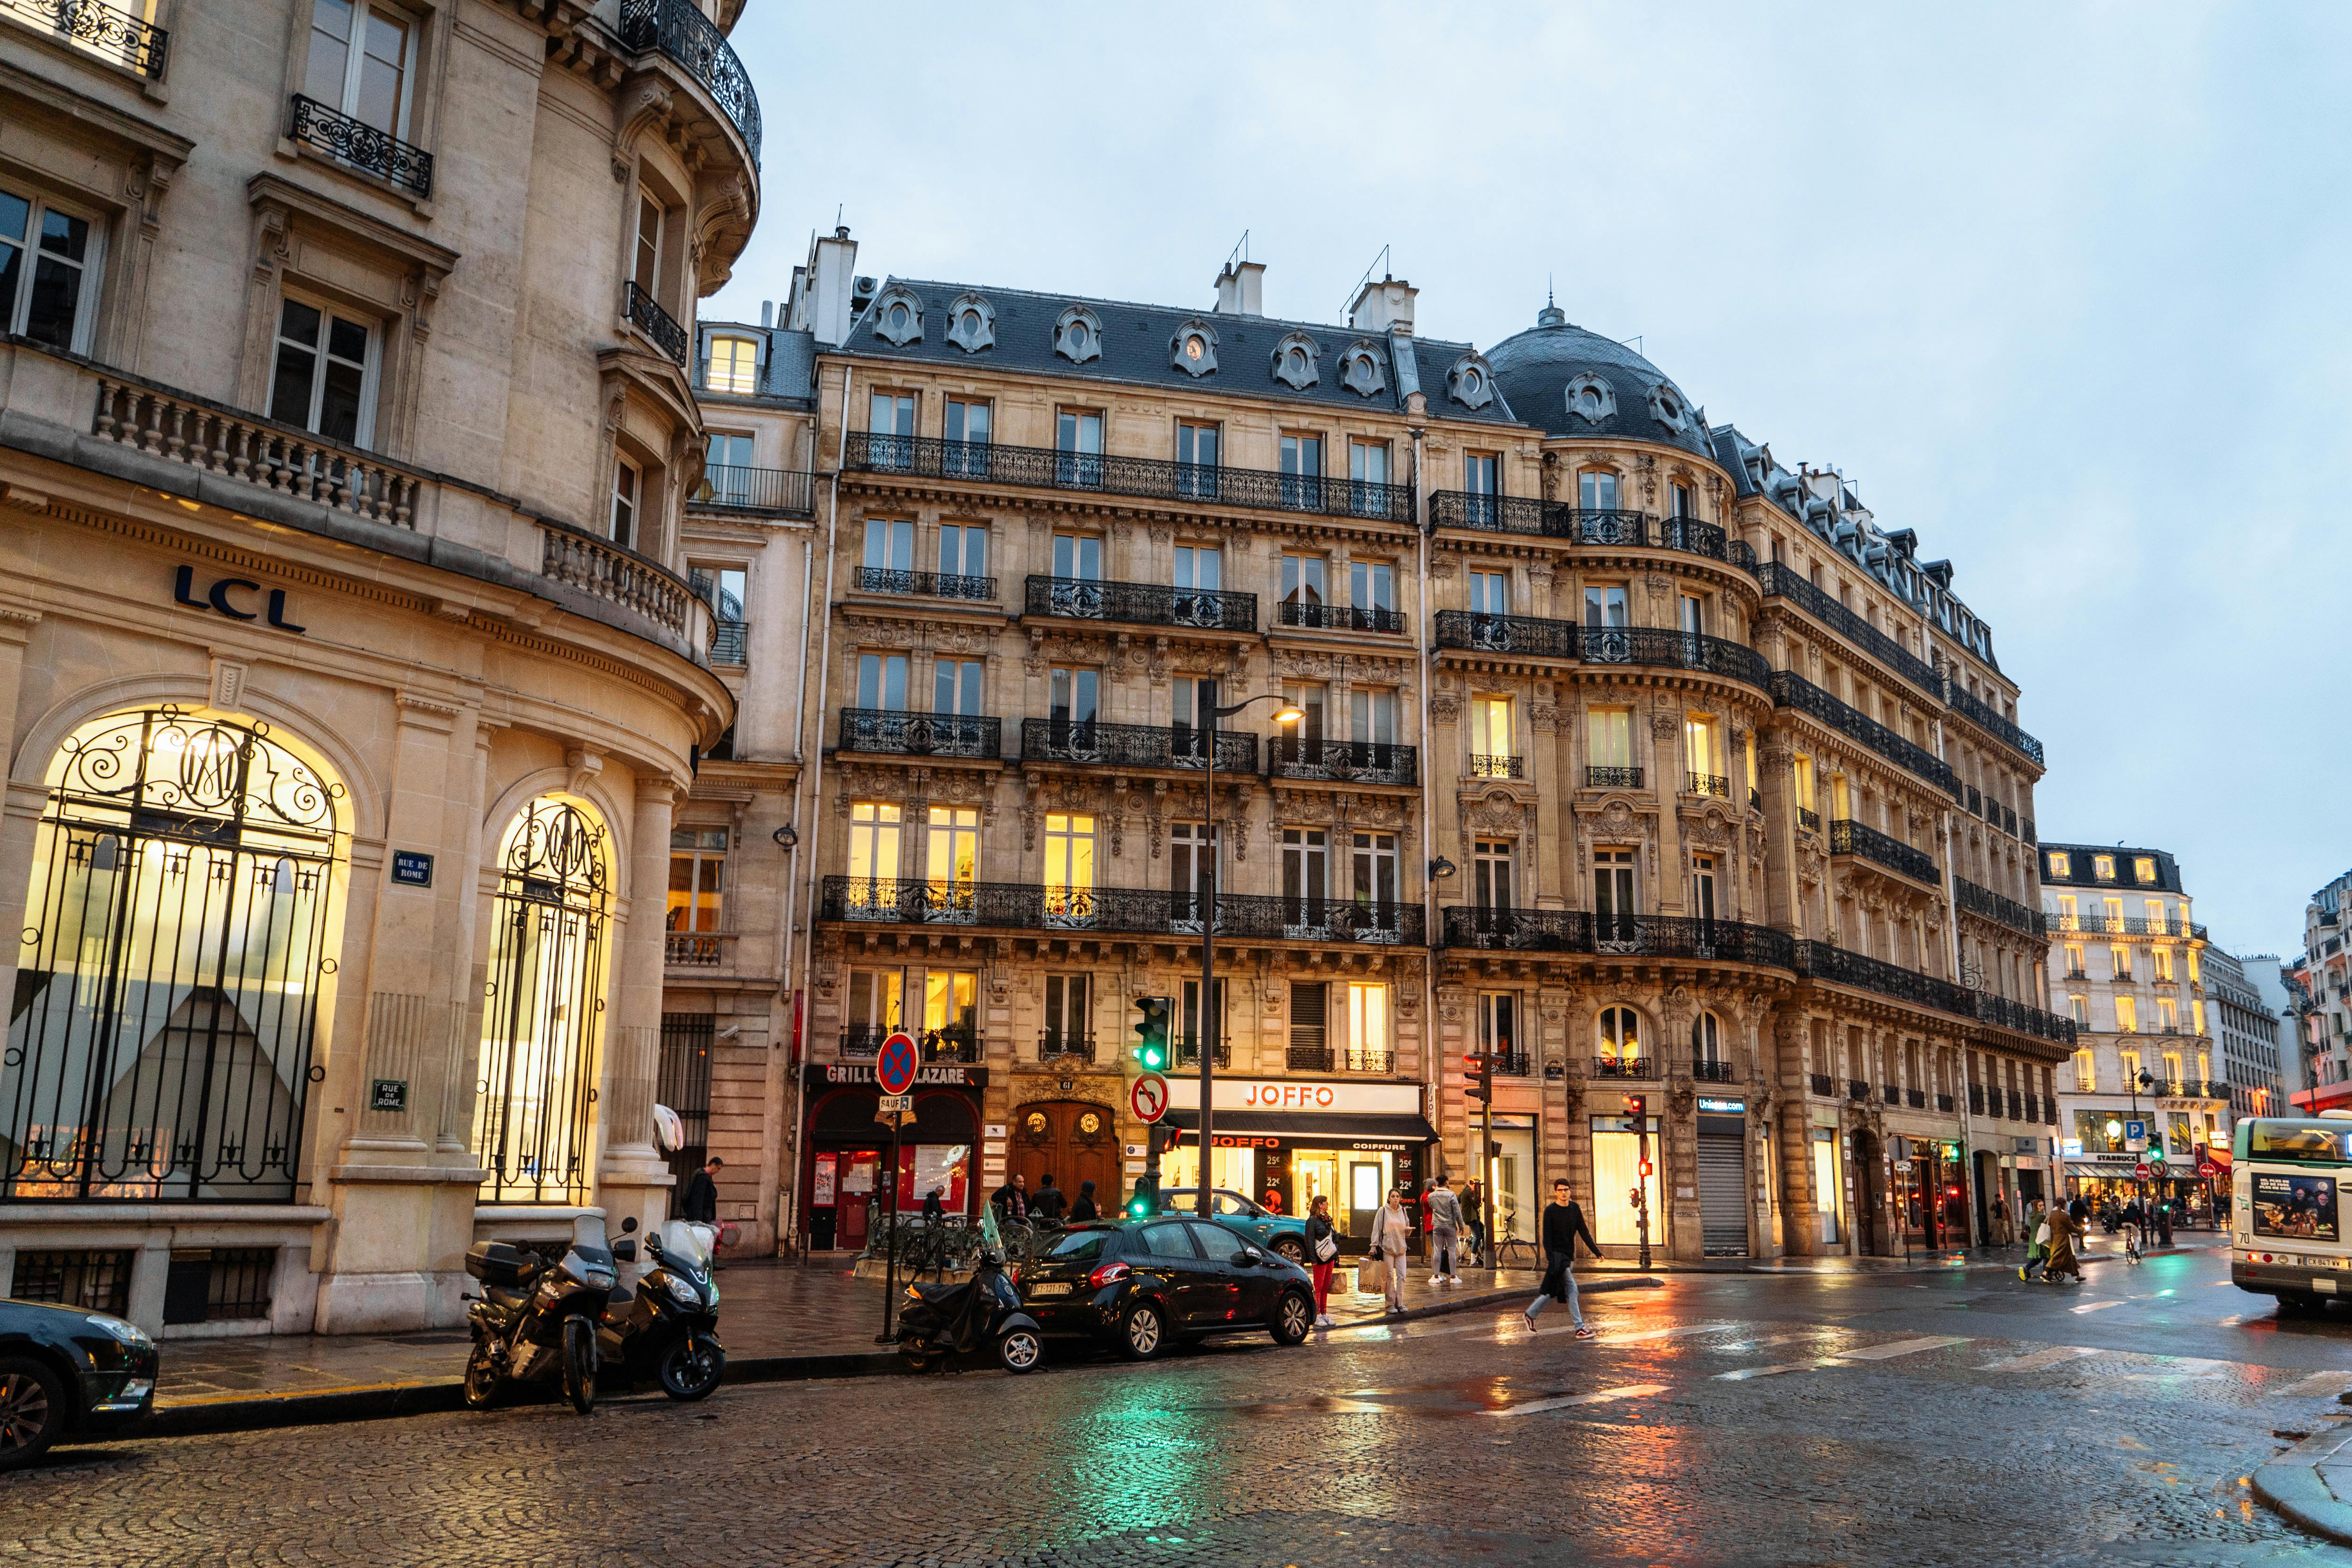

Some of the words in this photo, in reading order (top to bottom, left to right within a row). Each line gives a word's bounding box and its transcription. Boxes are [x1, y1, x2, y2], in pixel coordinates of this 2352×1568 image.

[175, 565, 306, 632] LCL
[398, 859, 413, 868] RUE
[401, 869, 423, 879] ROME
[827, 1066, 871, 1082] GRILL
[1246, 1085, 1334, 1106] JOFFO
[881, 1099, 899, 1108] SAUF
[2130, 1124, 2140, 1136] P
[1212, 1137, 1279, 1148] JOFFO
[1267, 1156, 1280, 1165] 25€
[1267, 1178, 1280, 1186] 22€
[2239, 1233, 2250, 1243] 70
[1359, 1282, 1382, 1292] ershka
